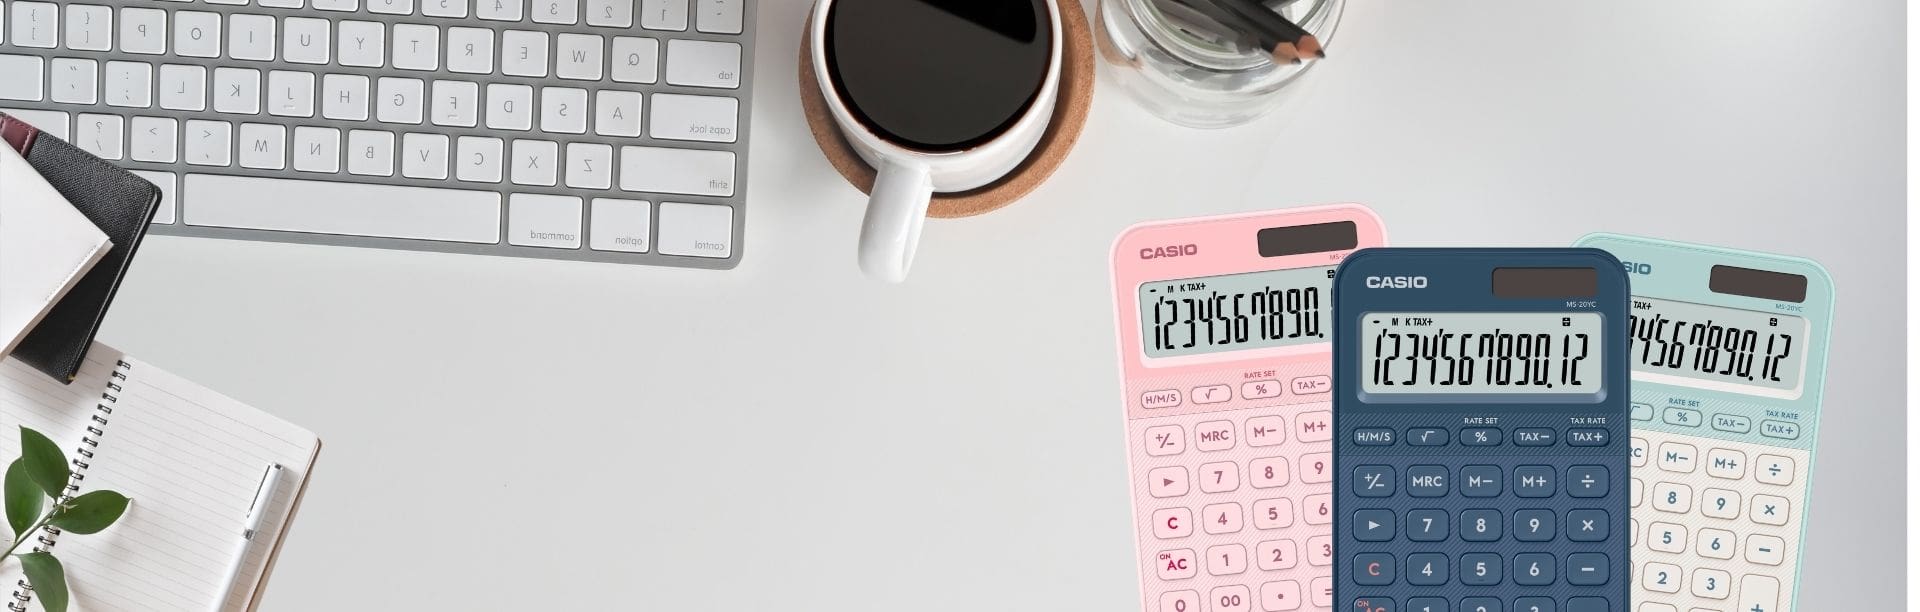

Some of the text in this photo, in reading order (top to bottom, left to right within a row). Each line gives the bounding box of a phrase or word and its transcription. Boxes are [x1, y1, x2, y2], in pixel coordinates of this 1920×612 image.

[1140, 244, 1197, 260] CASIO
[1180, 284, 1185, 292] K
[1187, 282, 1206, 291] TAX+
[1366, 276, 1428, 288] CASIO
[1634, 300, 1652, 310] TAX+
[1392, 318, 1432, 326] M K TAX+
[1256, 384, 1267, 394] %
[1146, 394, 1177, 403] H/M/S
[1669, 398, 1685, 406] RATE
[1678, 413, 1687, 422] %
[1766, 410, 1779, 418] TAX
[1304, 422, 1326, 433] M+
[1767, 424, 1793, 434] TAX+
[1201, 431, 1229, 442] MRC
[1358, 432, 1390, 441] H/M/S
[1476, 432, 1487, 442] %
[1574, 433, 1602, 441] TAX+
[1315, 462, 1323, 474] 9
[1715, 458, 1737, 469] M+
[1214, 471, 1223, 483] 7
[1265, 467, 1273, 479] 8
[1413, 476, 1442, 487] MRC
[1522, 476, 1546, 487] M+
[1668, 492, 1676, 504] 8
[1717, 498, 1725, 510] 9
[1269, 508, 1277, 520] 5
[1319, 503, 1327, 515] 6
[1168, 517, 1177, 529] C
[1218, 512, 1227, 525] 4
[1423, 519, 1432, 532] 7
[1476, 519, 1486, 532] 8
[1530, 519, 1539, 532] 9
[1663, 532, 1671, 543] 5
[1712, 538, 1720, 550] 6
[1273, 549, 1282, 561] 2
[1323, 544, 1332, 557] 3
[1167, 559, 1187, 570] AC
[1223, 554, 1228, 566] 1
[1368, 563, 1380, 576] C
[1422, 563, 1432, 576] 4
[1476, 563, 1486, 576] 5
[1530, 562, 1539, 576] 6
[1658, 572, 1667, 584] 2
[1707, 578, 1715, 590] 3
[1221, 595, 1240, 607] 00
